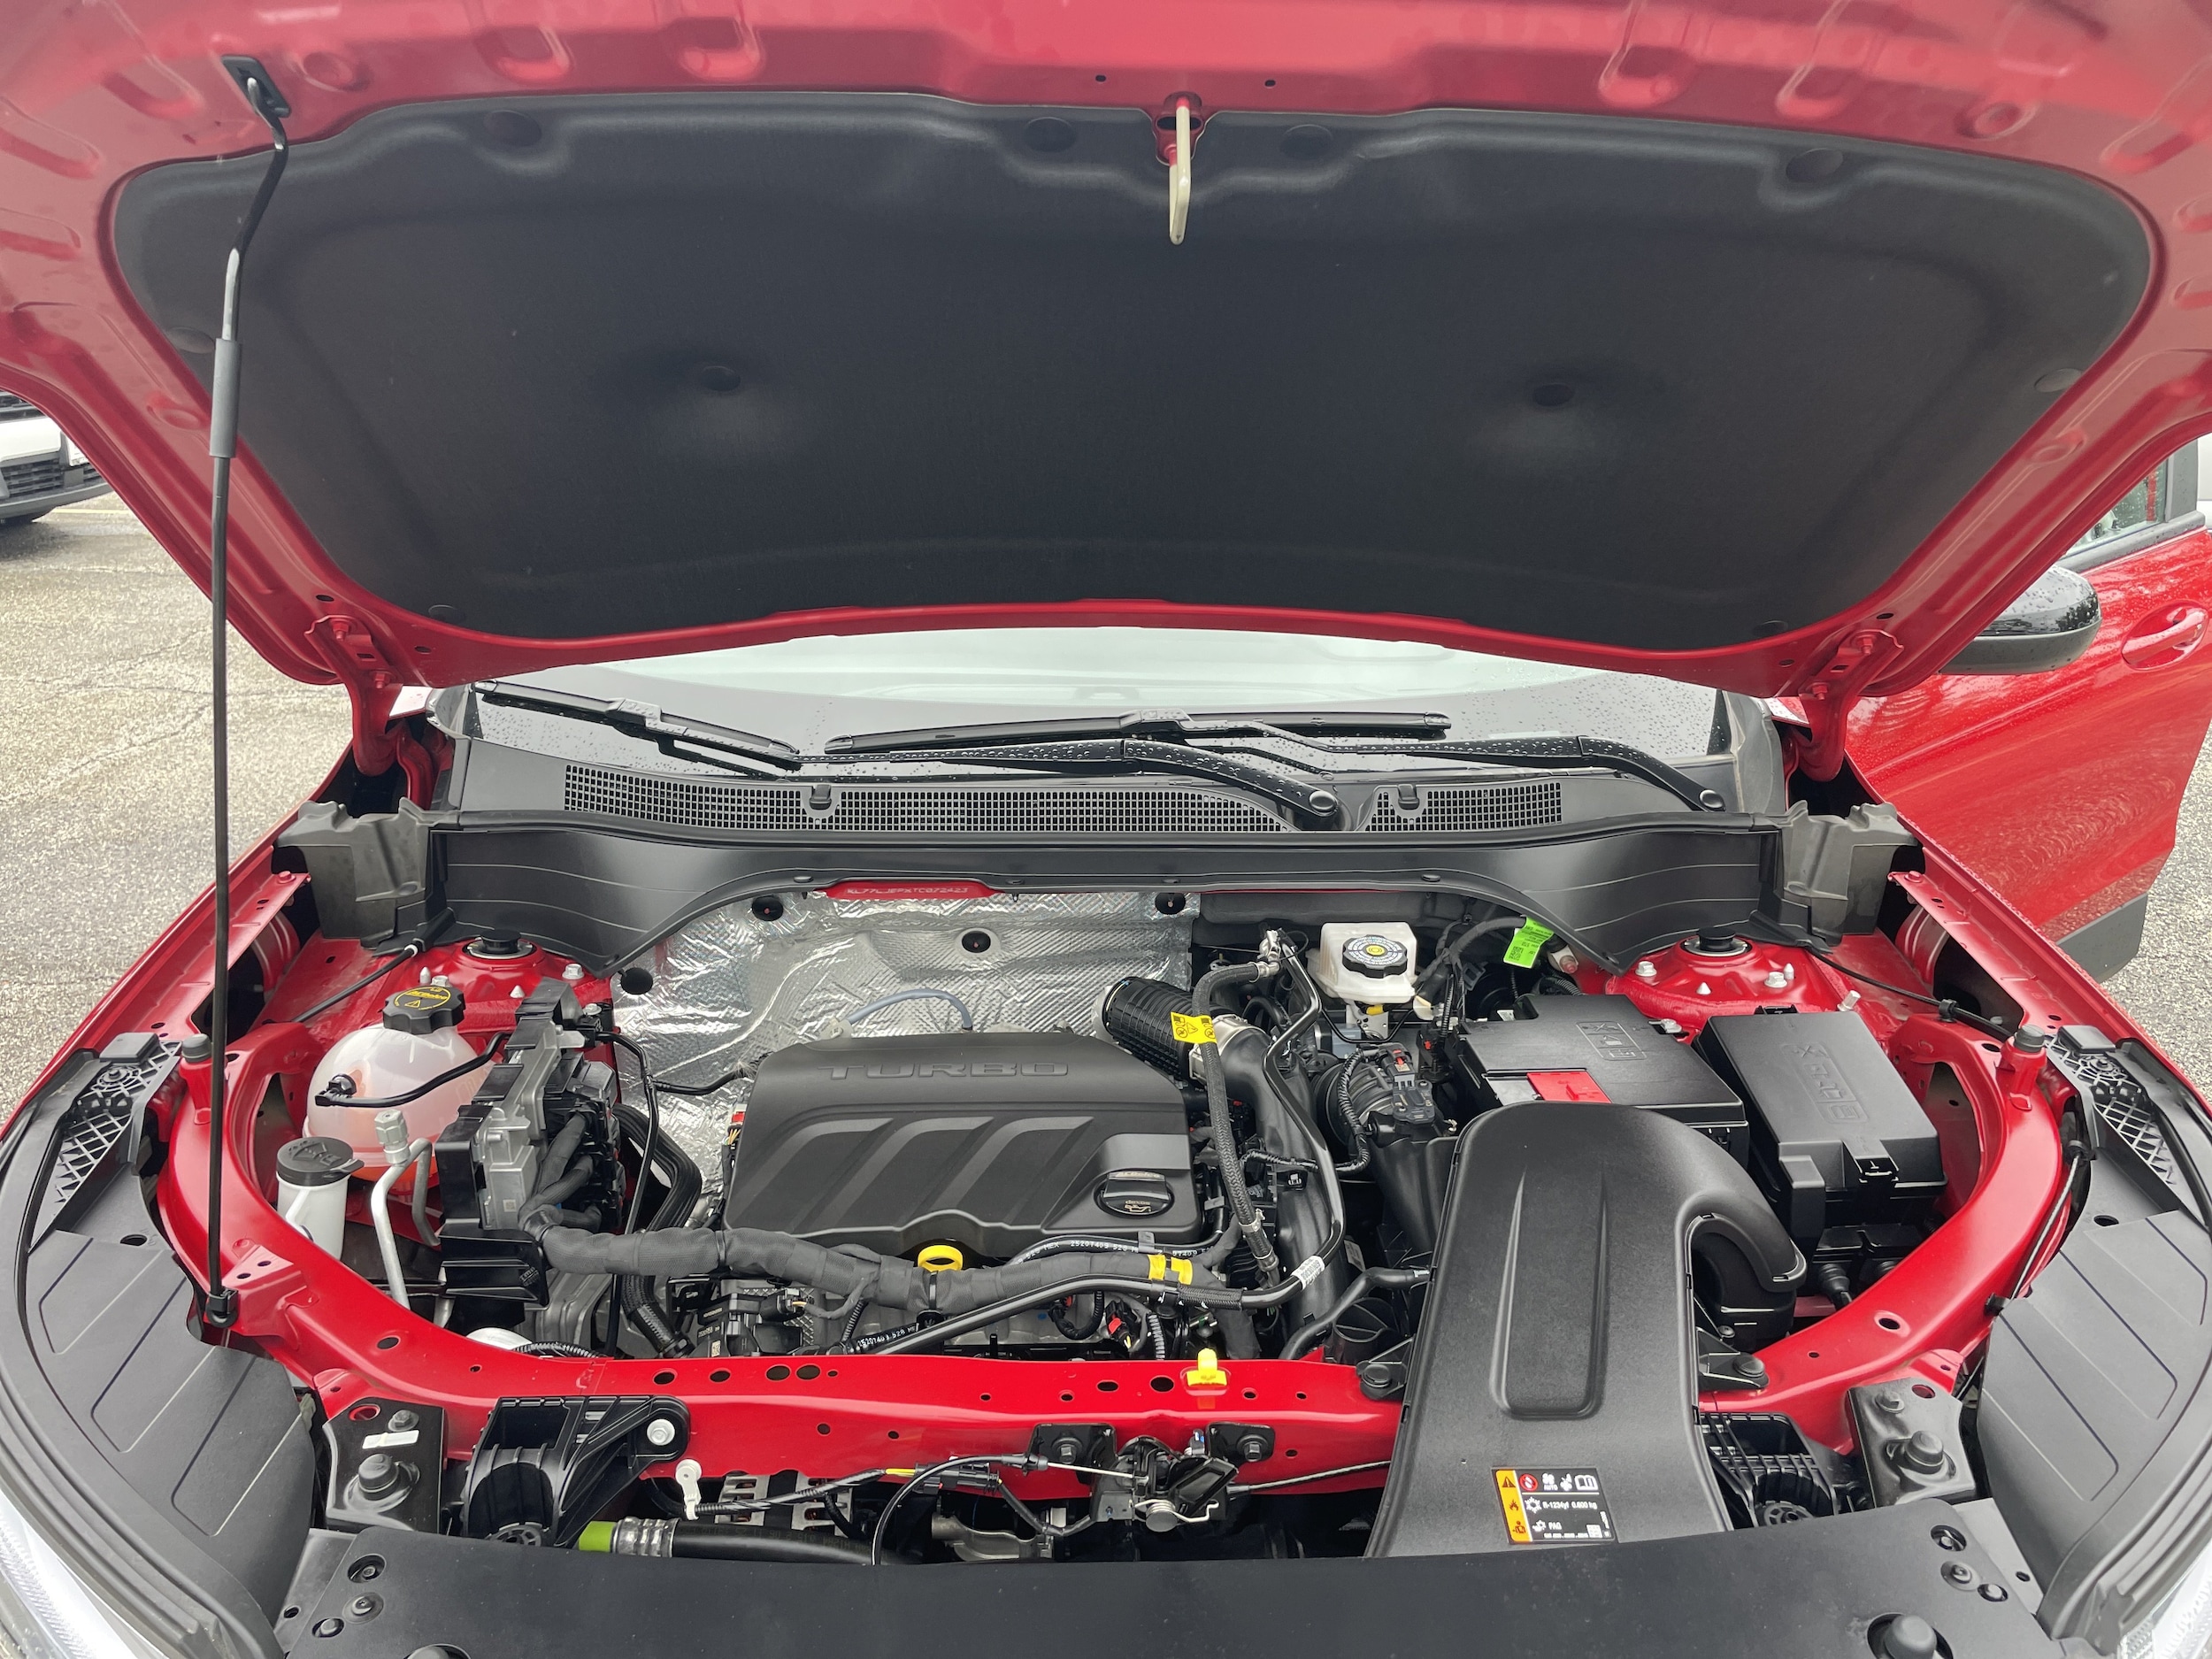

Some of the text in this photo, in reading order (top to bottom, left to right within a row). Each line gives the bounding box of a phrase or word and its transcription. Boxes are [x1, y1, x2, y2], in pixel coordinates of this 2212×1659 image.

[817, 1063, 1069, 1080] TURBO
[1044, 1241, 1060, 1250] MEX
[1542, 1501, 1570, 1509] R-1234yf
